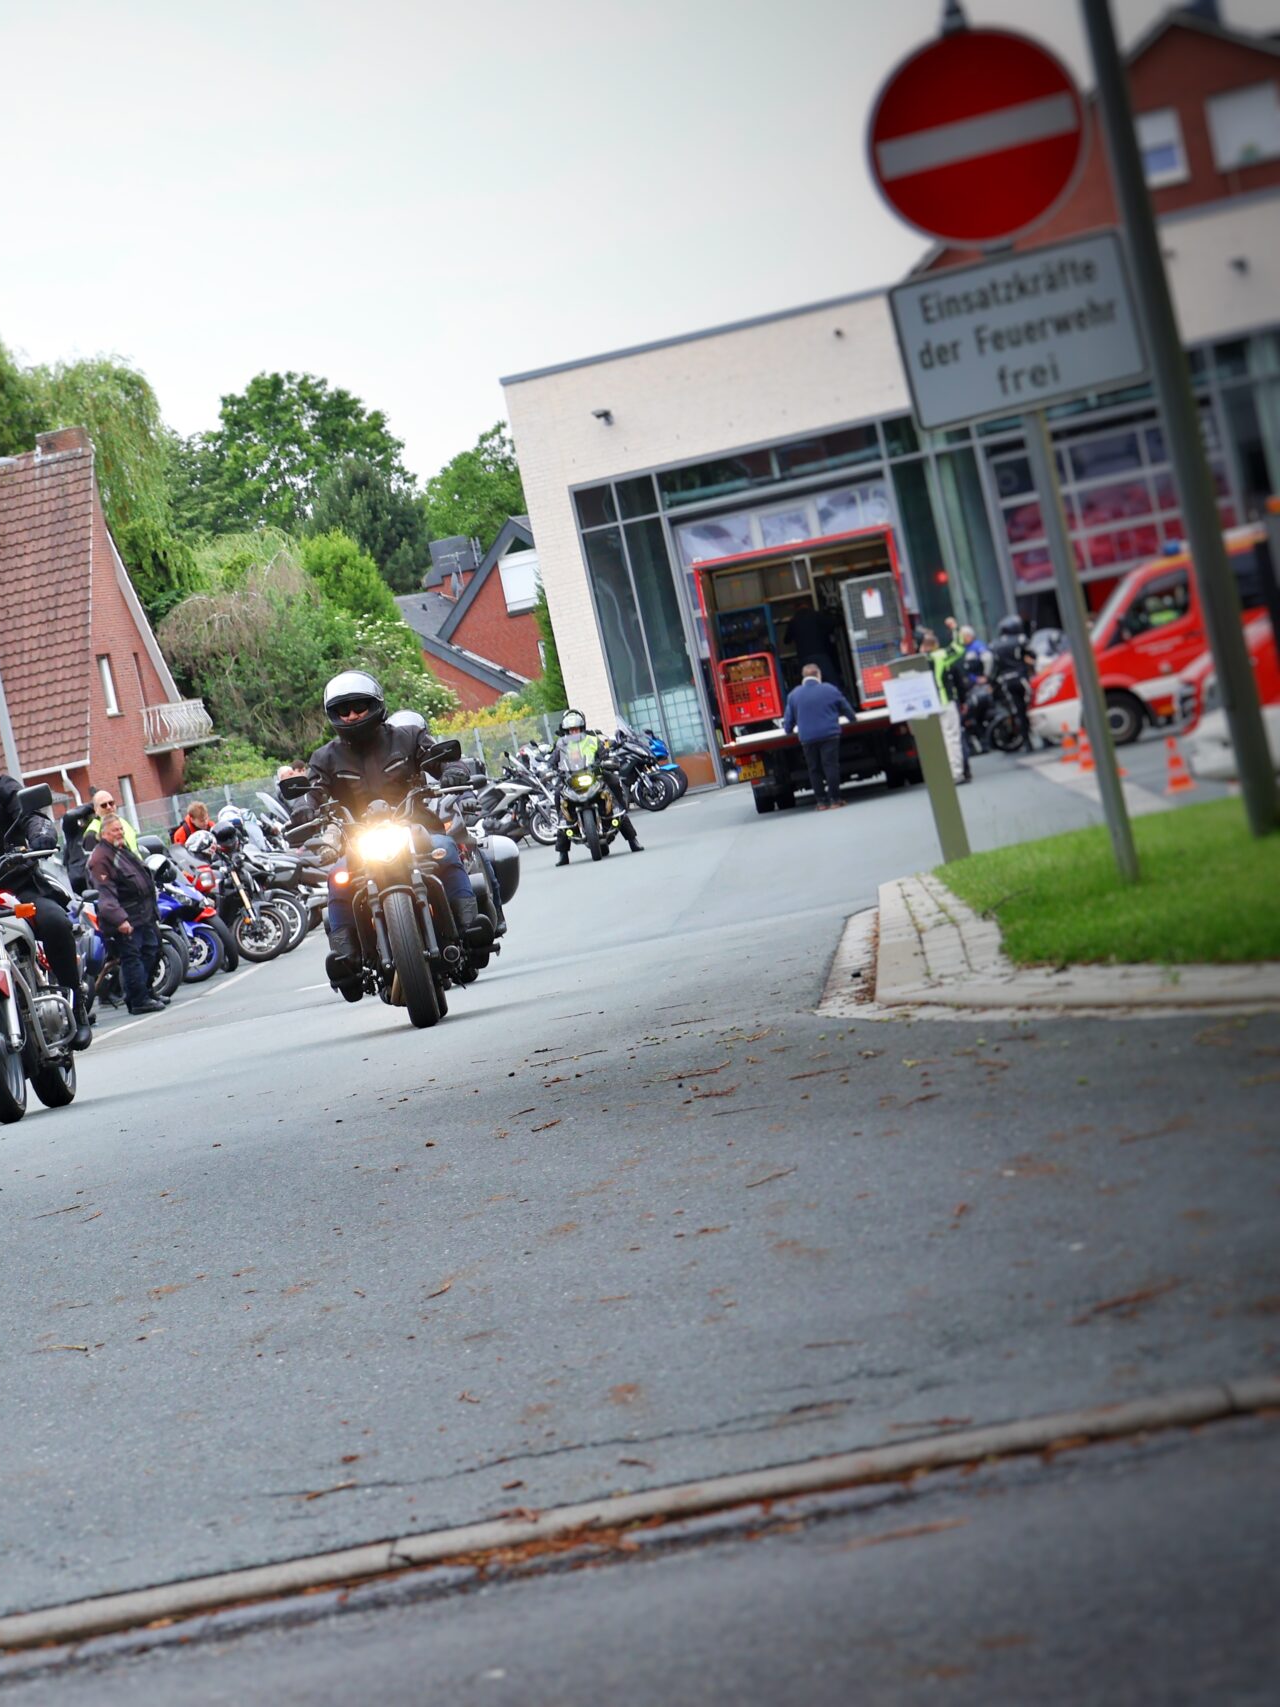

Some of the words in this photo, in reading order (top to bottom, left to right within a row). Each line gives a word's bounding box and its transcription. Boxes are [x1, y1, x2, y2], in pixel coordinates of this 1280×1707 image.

[918, 258, 1096, 324] Einsatzkräfte
[918, 338, 962, 371] der
[974, 299, 1117, 355] Feuerwehr
[998, 353, 1061, 395] frei
